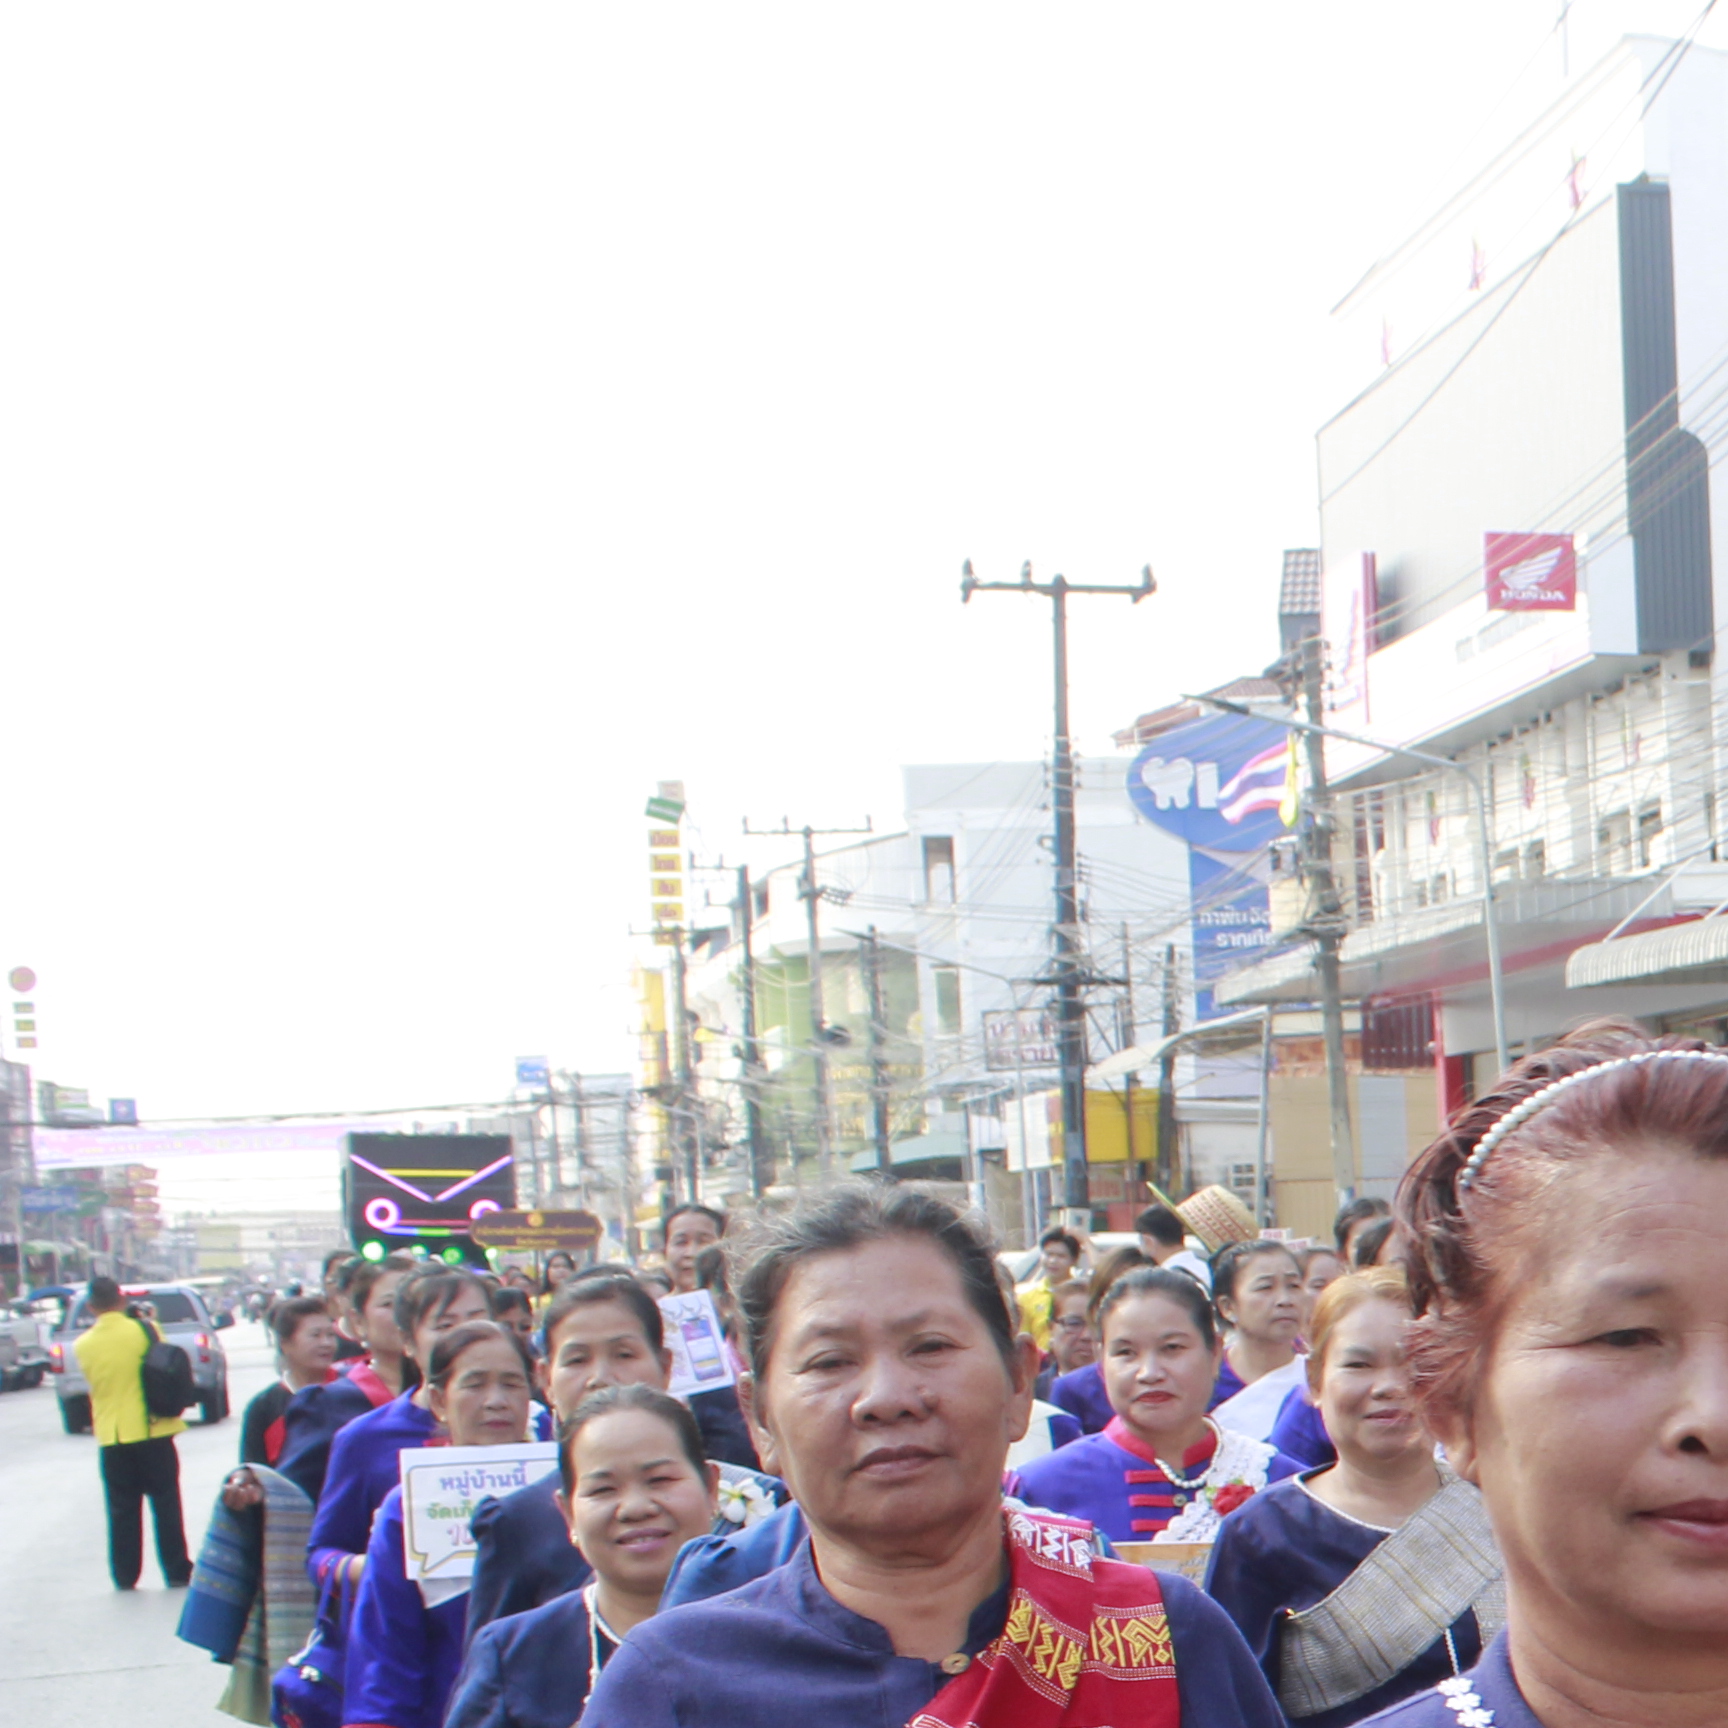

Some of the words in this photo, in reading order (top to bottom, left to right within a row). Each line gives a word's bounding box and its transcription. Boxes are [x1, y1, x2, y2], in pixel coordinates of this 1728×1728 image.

[1500, 589, 1567, 602] HONDA
[440, 1460, 528, 1498] หมู่บ้านนี้
